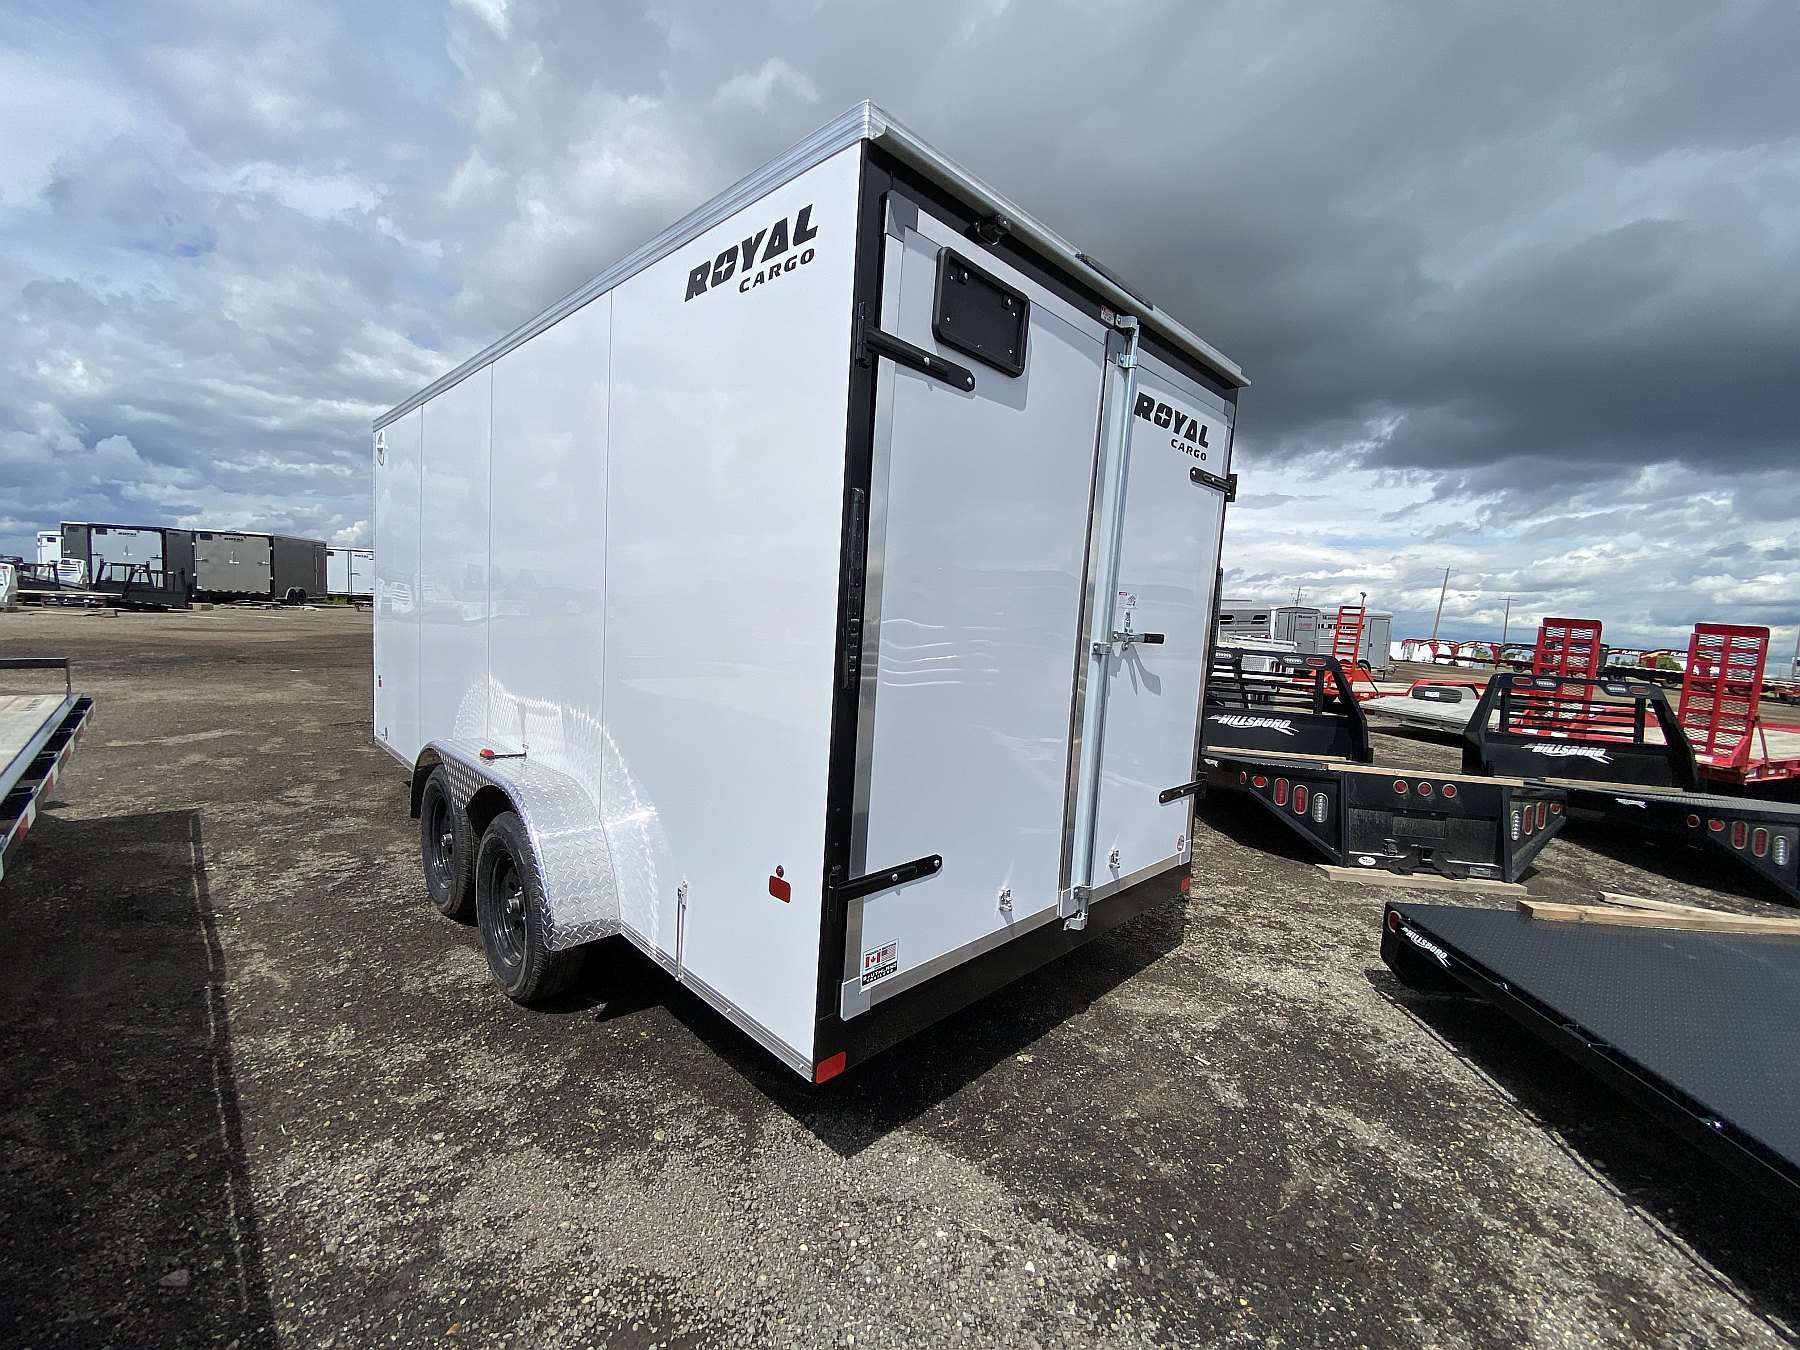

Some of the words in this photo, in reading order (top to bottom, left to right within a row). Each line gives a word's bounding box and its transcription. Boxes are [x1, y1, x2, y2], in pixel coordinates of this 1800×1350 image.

[685, 204, 818, 302] ROYAL
[739, 249, 815, 293] CARGO
[1134, 392, 1209, 448] ROYAL
[1171, 438, 1207, 461] CARGO
[1217, 714, 1293, 731] HILLSBORO
[1531, 743, 1608, 759] HILLSBORO
[1405, 929, 1449, 961] HILLSBORO
